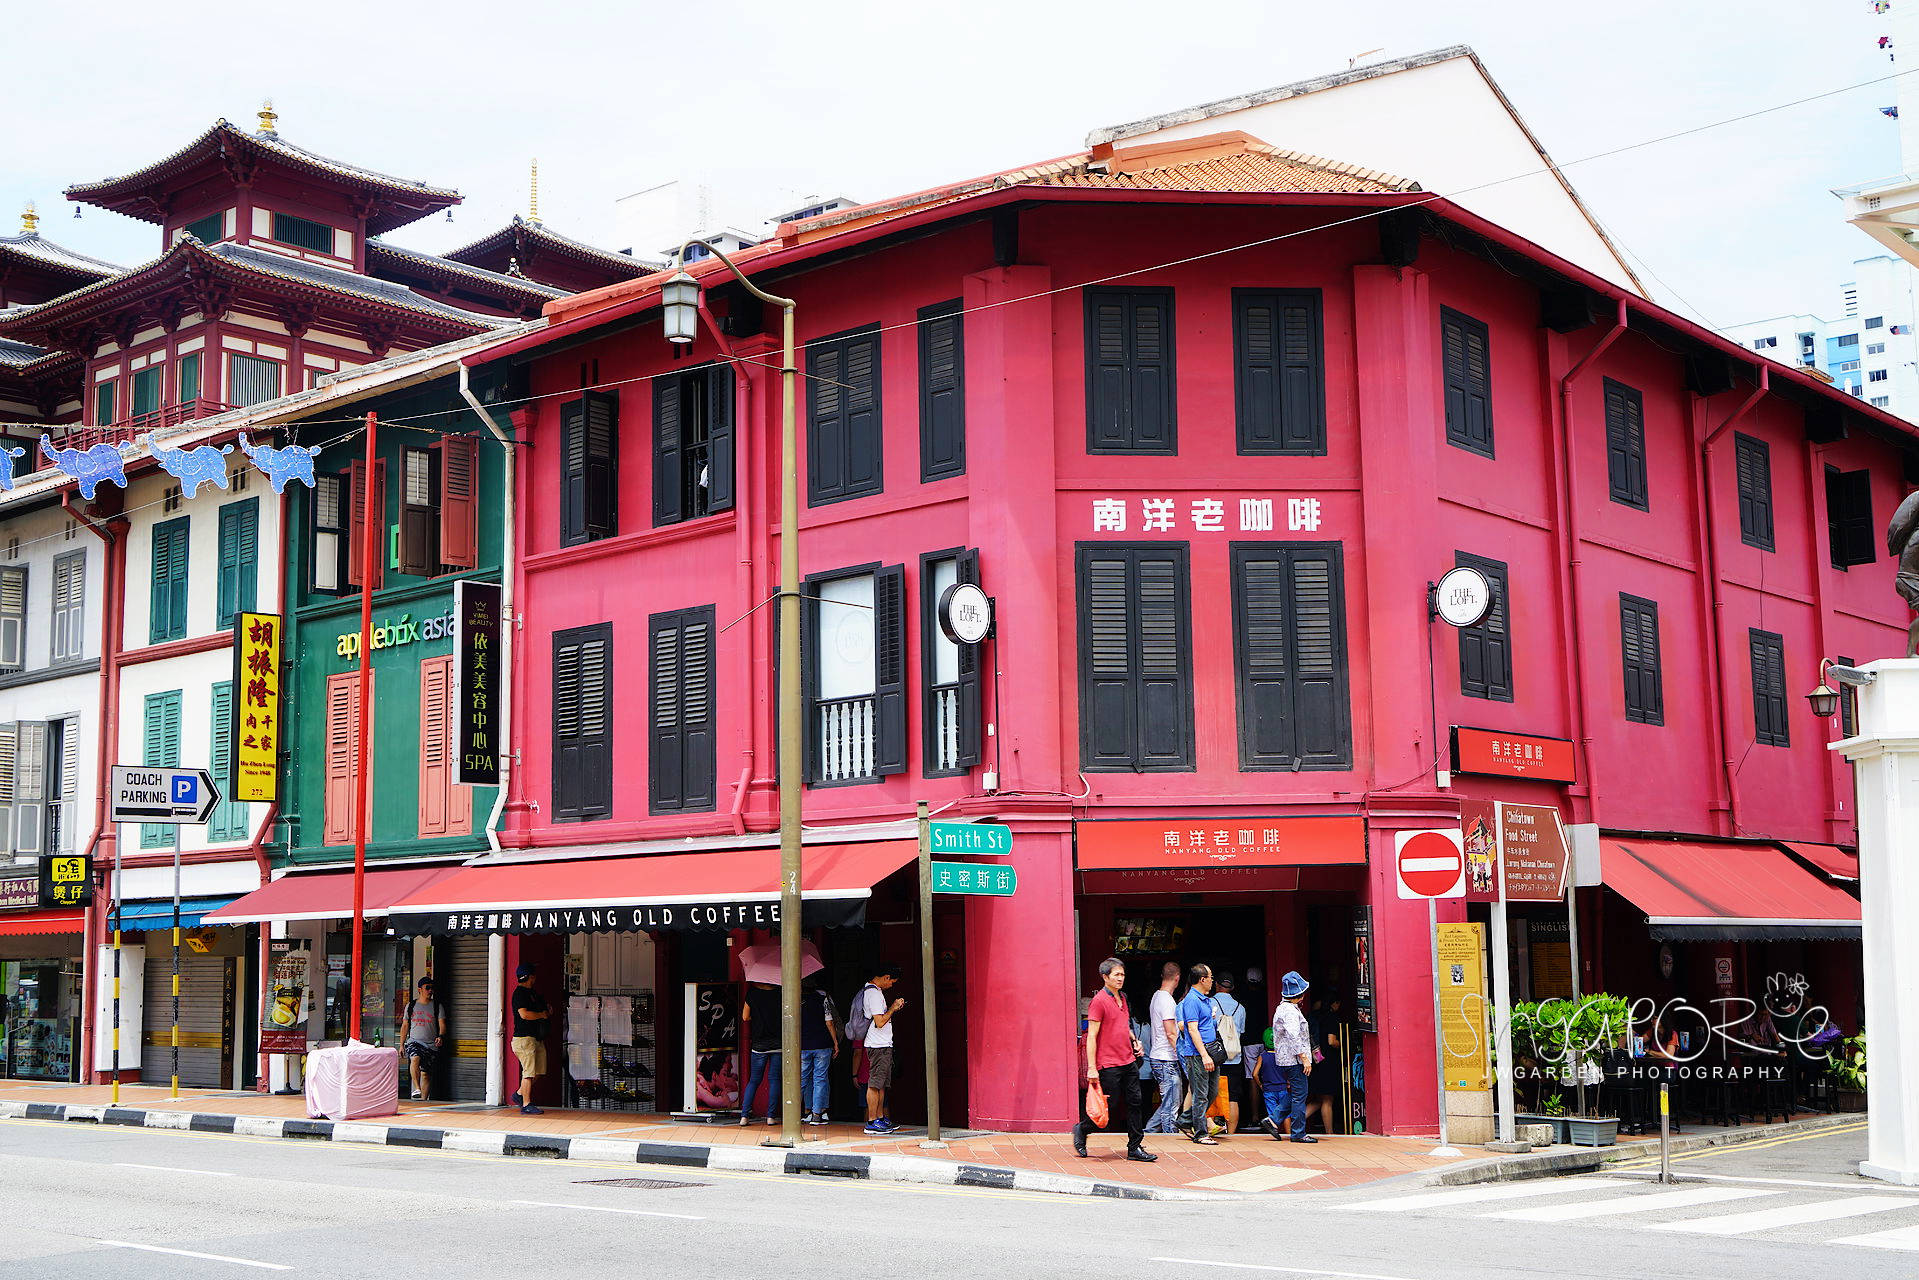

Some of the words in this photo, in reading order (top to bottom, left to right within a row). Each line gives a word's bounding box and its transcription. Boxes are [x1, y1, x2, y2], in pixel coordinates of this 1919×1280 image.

[1092, 498, 1322, 532] 南洋老咖啡
[1455, 588, 1472, 597] THE
[962, 604, 978, 614] THE
[247, 617, 276, 708] 胡振隆
[472, 632, 488, 750] 依美美容中心
[1491, 740, 1543, 760] 南洋老咖啡
[465, 754, 494, 771] SPA
[126, 773, 162, 786] COACH
[177, 780, 192, 799] P
[251, 788, 263, 796] 272
[121, 790, 167, 803] PARKING
[934, 828, 981, 849] Smith
[987, 830, 1003, 849] St
[1163, 828, 1280, 847] 南洋老咖啡
[1505, 828, 1518, 842] Food
[1520, 829, 1538, 843] Street
[1165, 847, 1211, 855] NANYANG
[938, 868, 1011, 891] 史密斯街
[1121, 869, 1176, 878] NANYANG
[1184, 868, 1206, 876] OLD
[1213, 867, 1259, 876] COFFEE
[52, 885, 84, 900] 煲仔
[447, 912, 513, 930] 南洋老咖啡
[520, 909, 617, 929] NANYANG
[633, 907, 673, 926] OLD
[690, 904, 781, 925] COFFEE
[1531, 924, 1569, 932] SINGLIS
